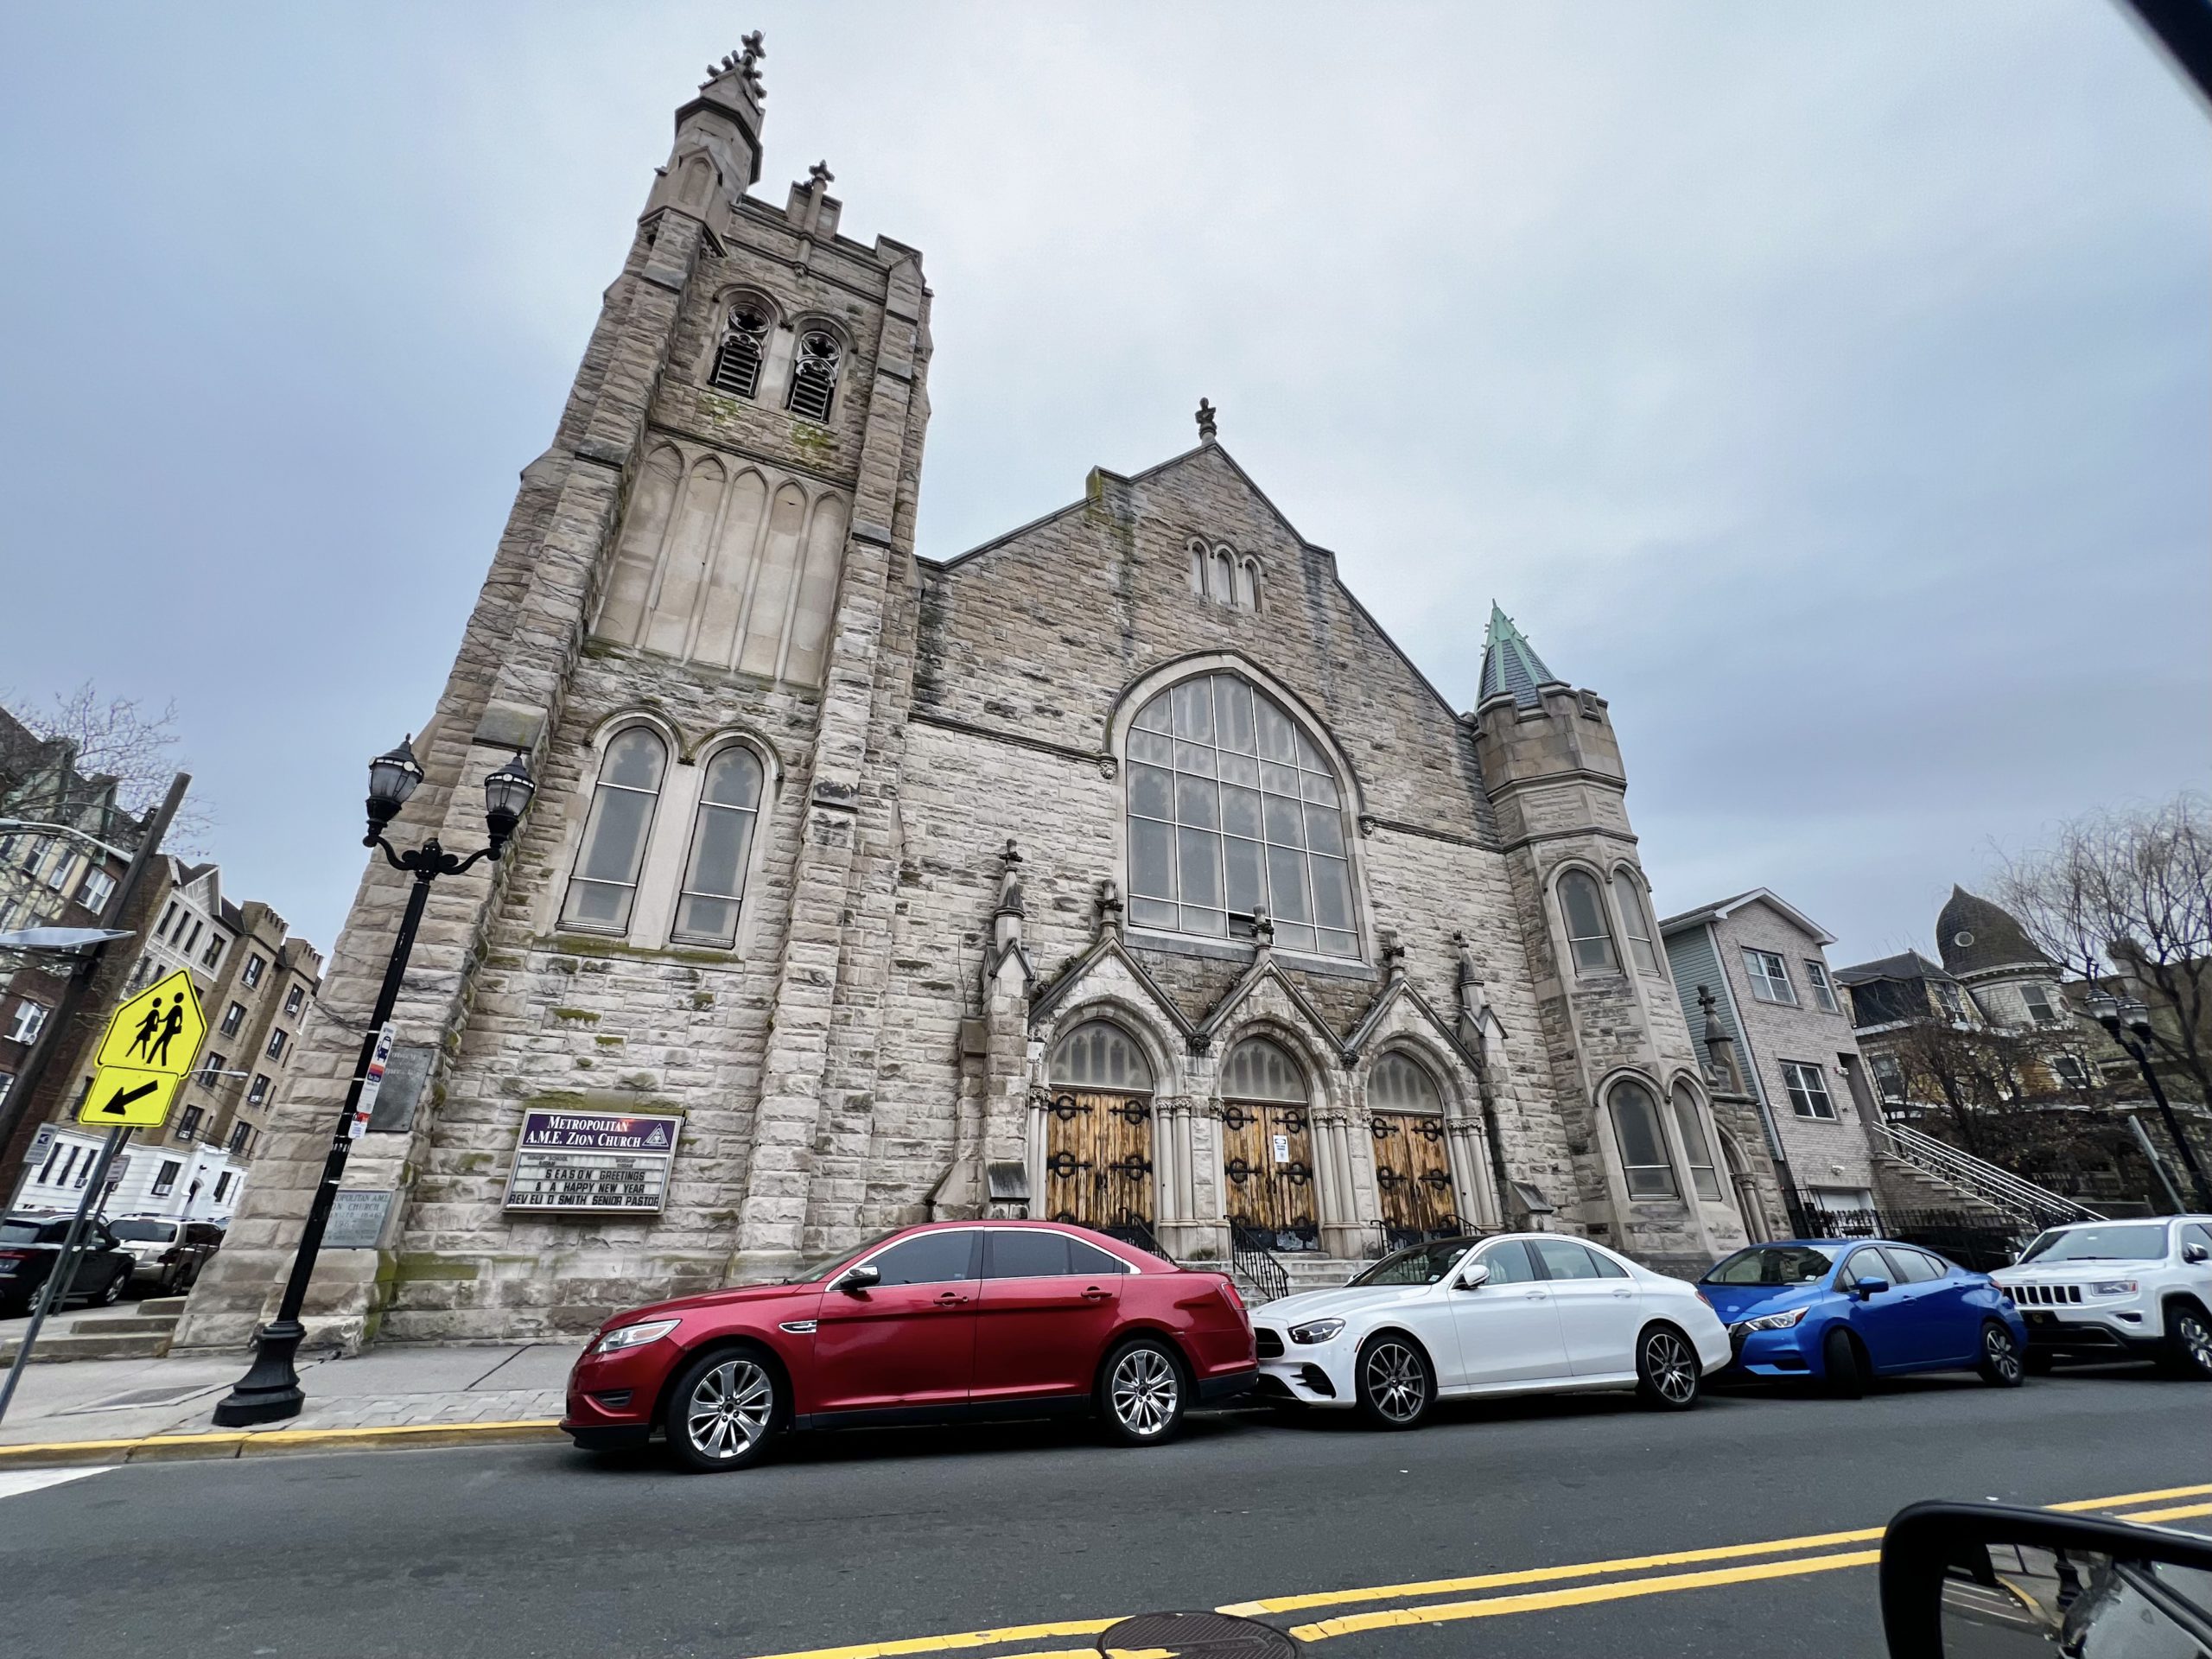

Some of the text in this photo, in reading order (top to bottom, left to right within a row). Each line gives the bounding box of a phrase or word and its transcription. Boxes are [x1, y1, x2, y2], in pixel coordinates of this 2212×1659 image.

[547, 1116, 629, 1132] METROPOLITAN
[525, 1130, 642, 1147] A.M.E. ZION CHURCH
[545, 1169, 645, 1181] SEASON GREETINGS
[536, 1181, 645, 1193] & A HAPPY NEW YEAR
[348, 1202, 380, 1211] CHURCH
[509, 1194, 659, 1207] REV ELI D SMITH SENIOR PASTOR
